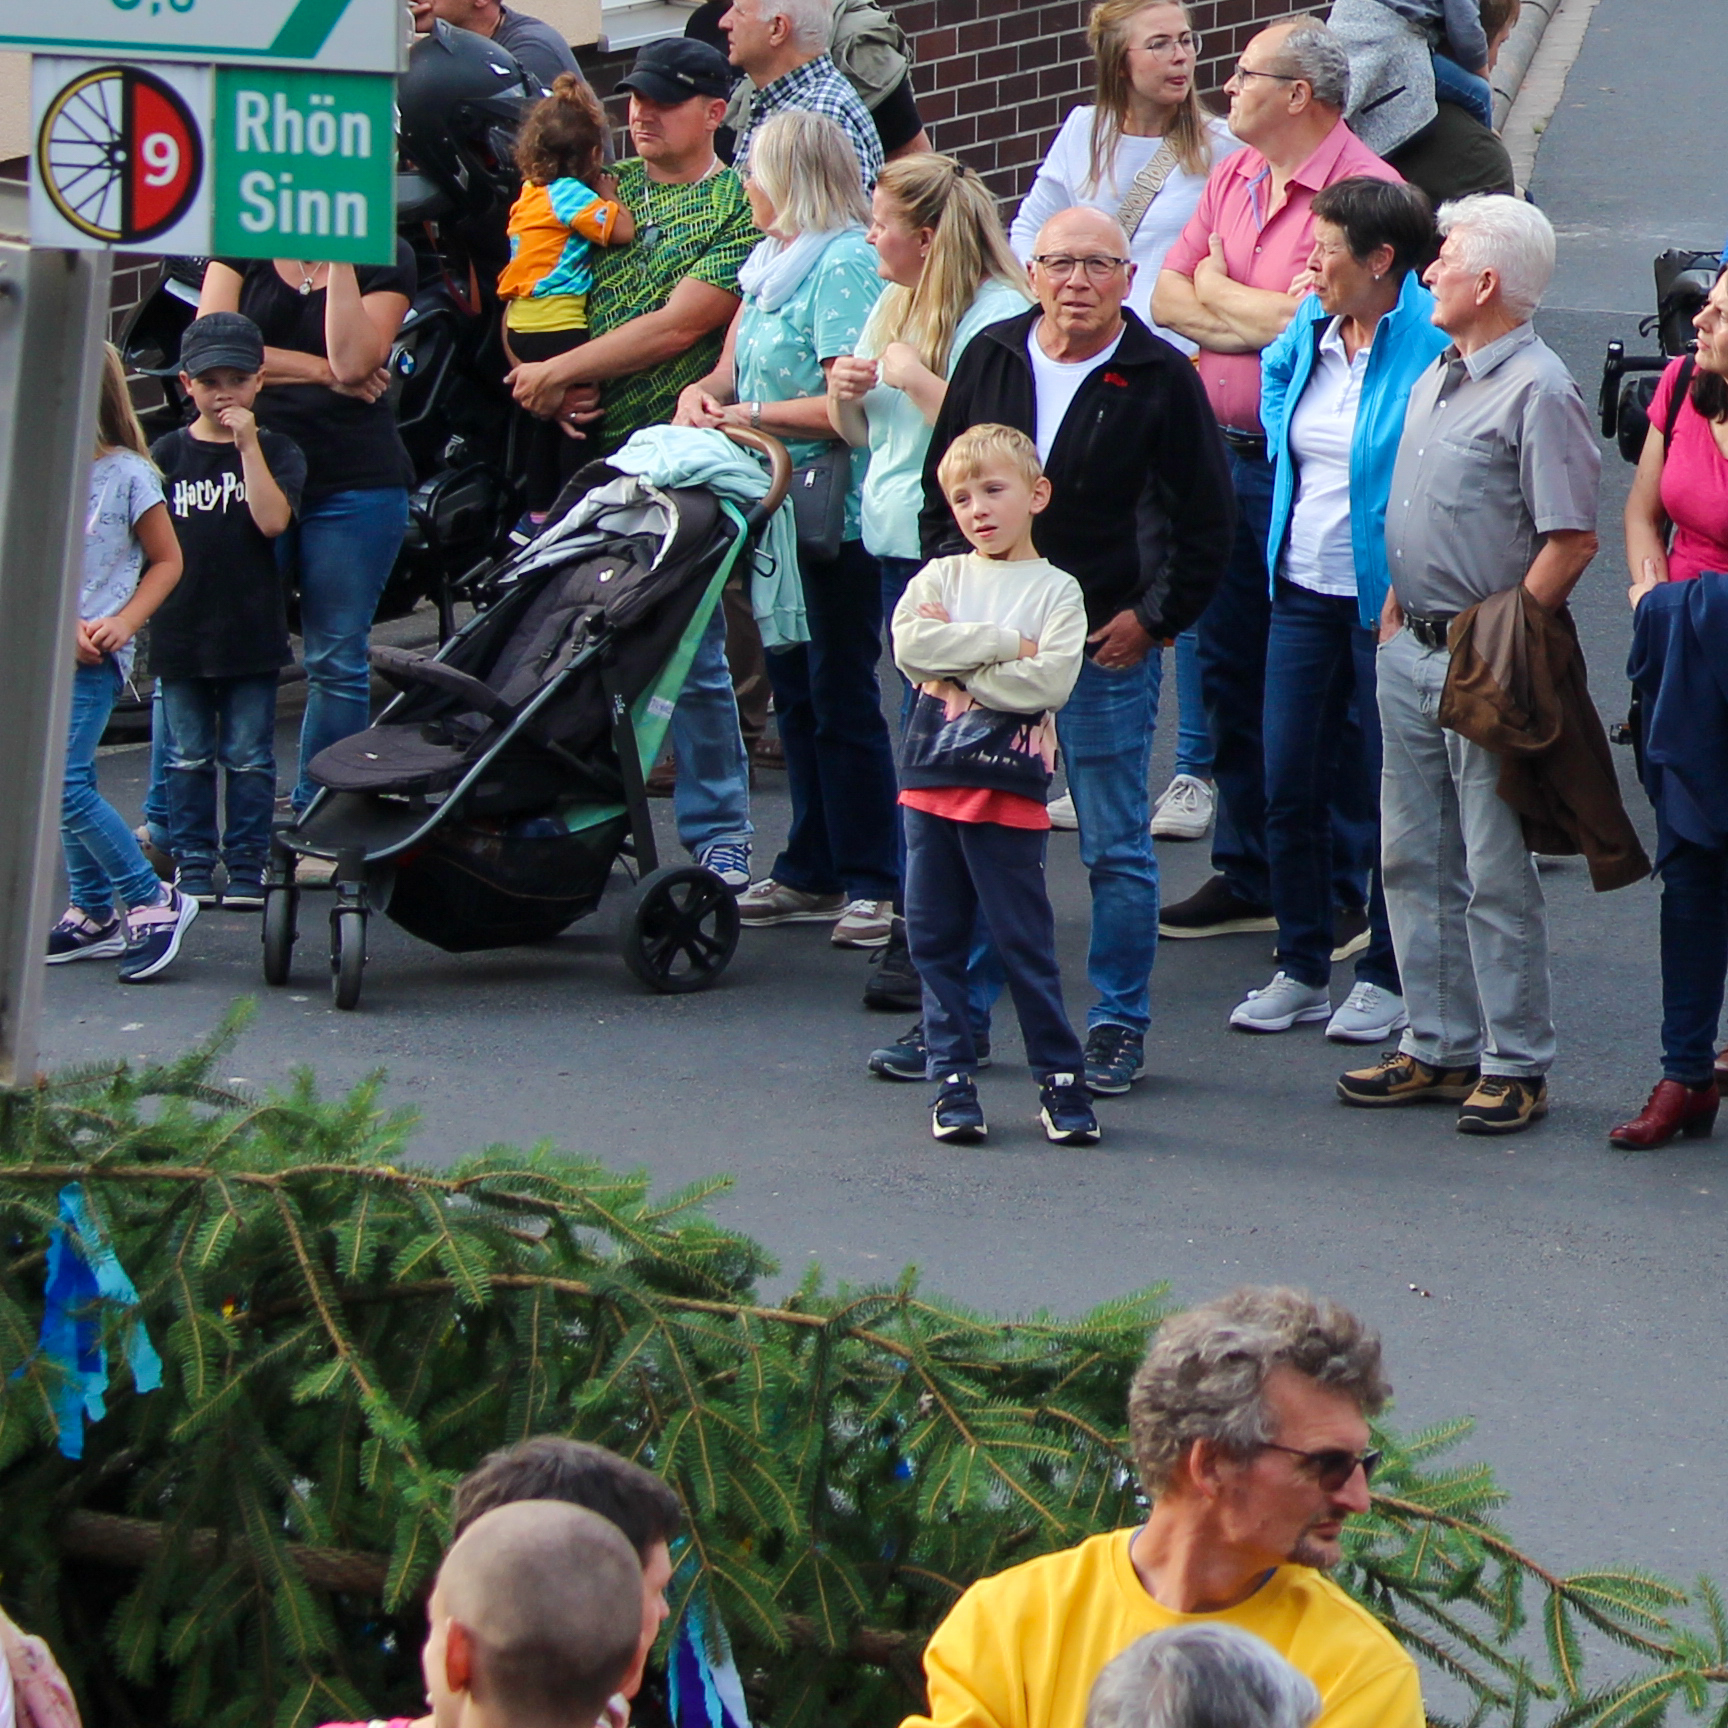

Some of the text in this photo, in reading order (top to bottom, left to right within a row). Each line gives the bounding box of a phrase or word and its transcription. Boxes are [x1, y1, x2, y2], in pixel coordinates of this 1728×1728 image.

[236, 90, 372, 159] Rhön
[142, 132, 180, 187] 9
[239, 170, 369, 239] Sinn
[173, 478, 222, 518] Harry
